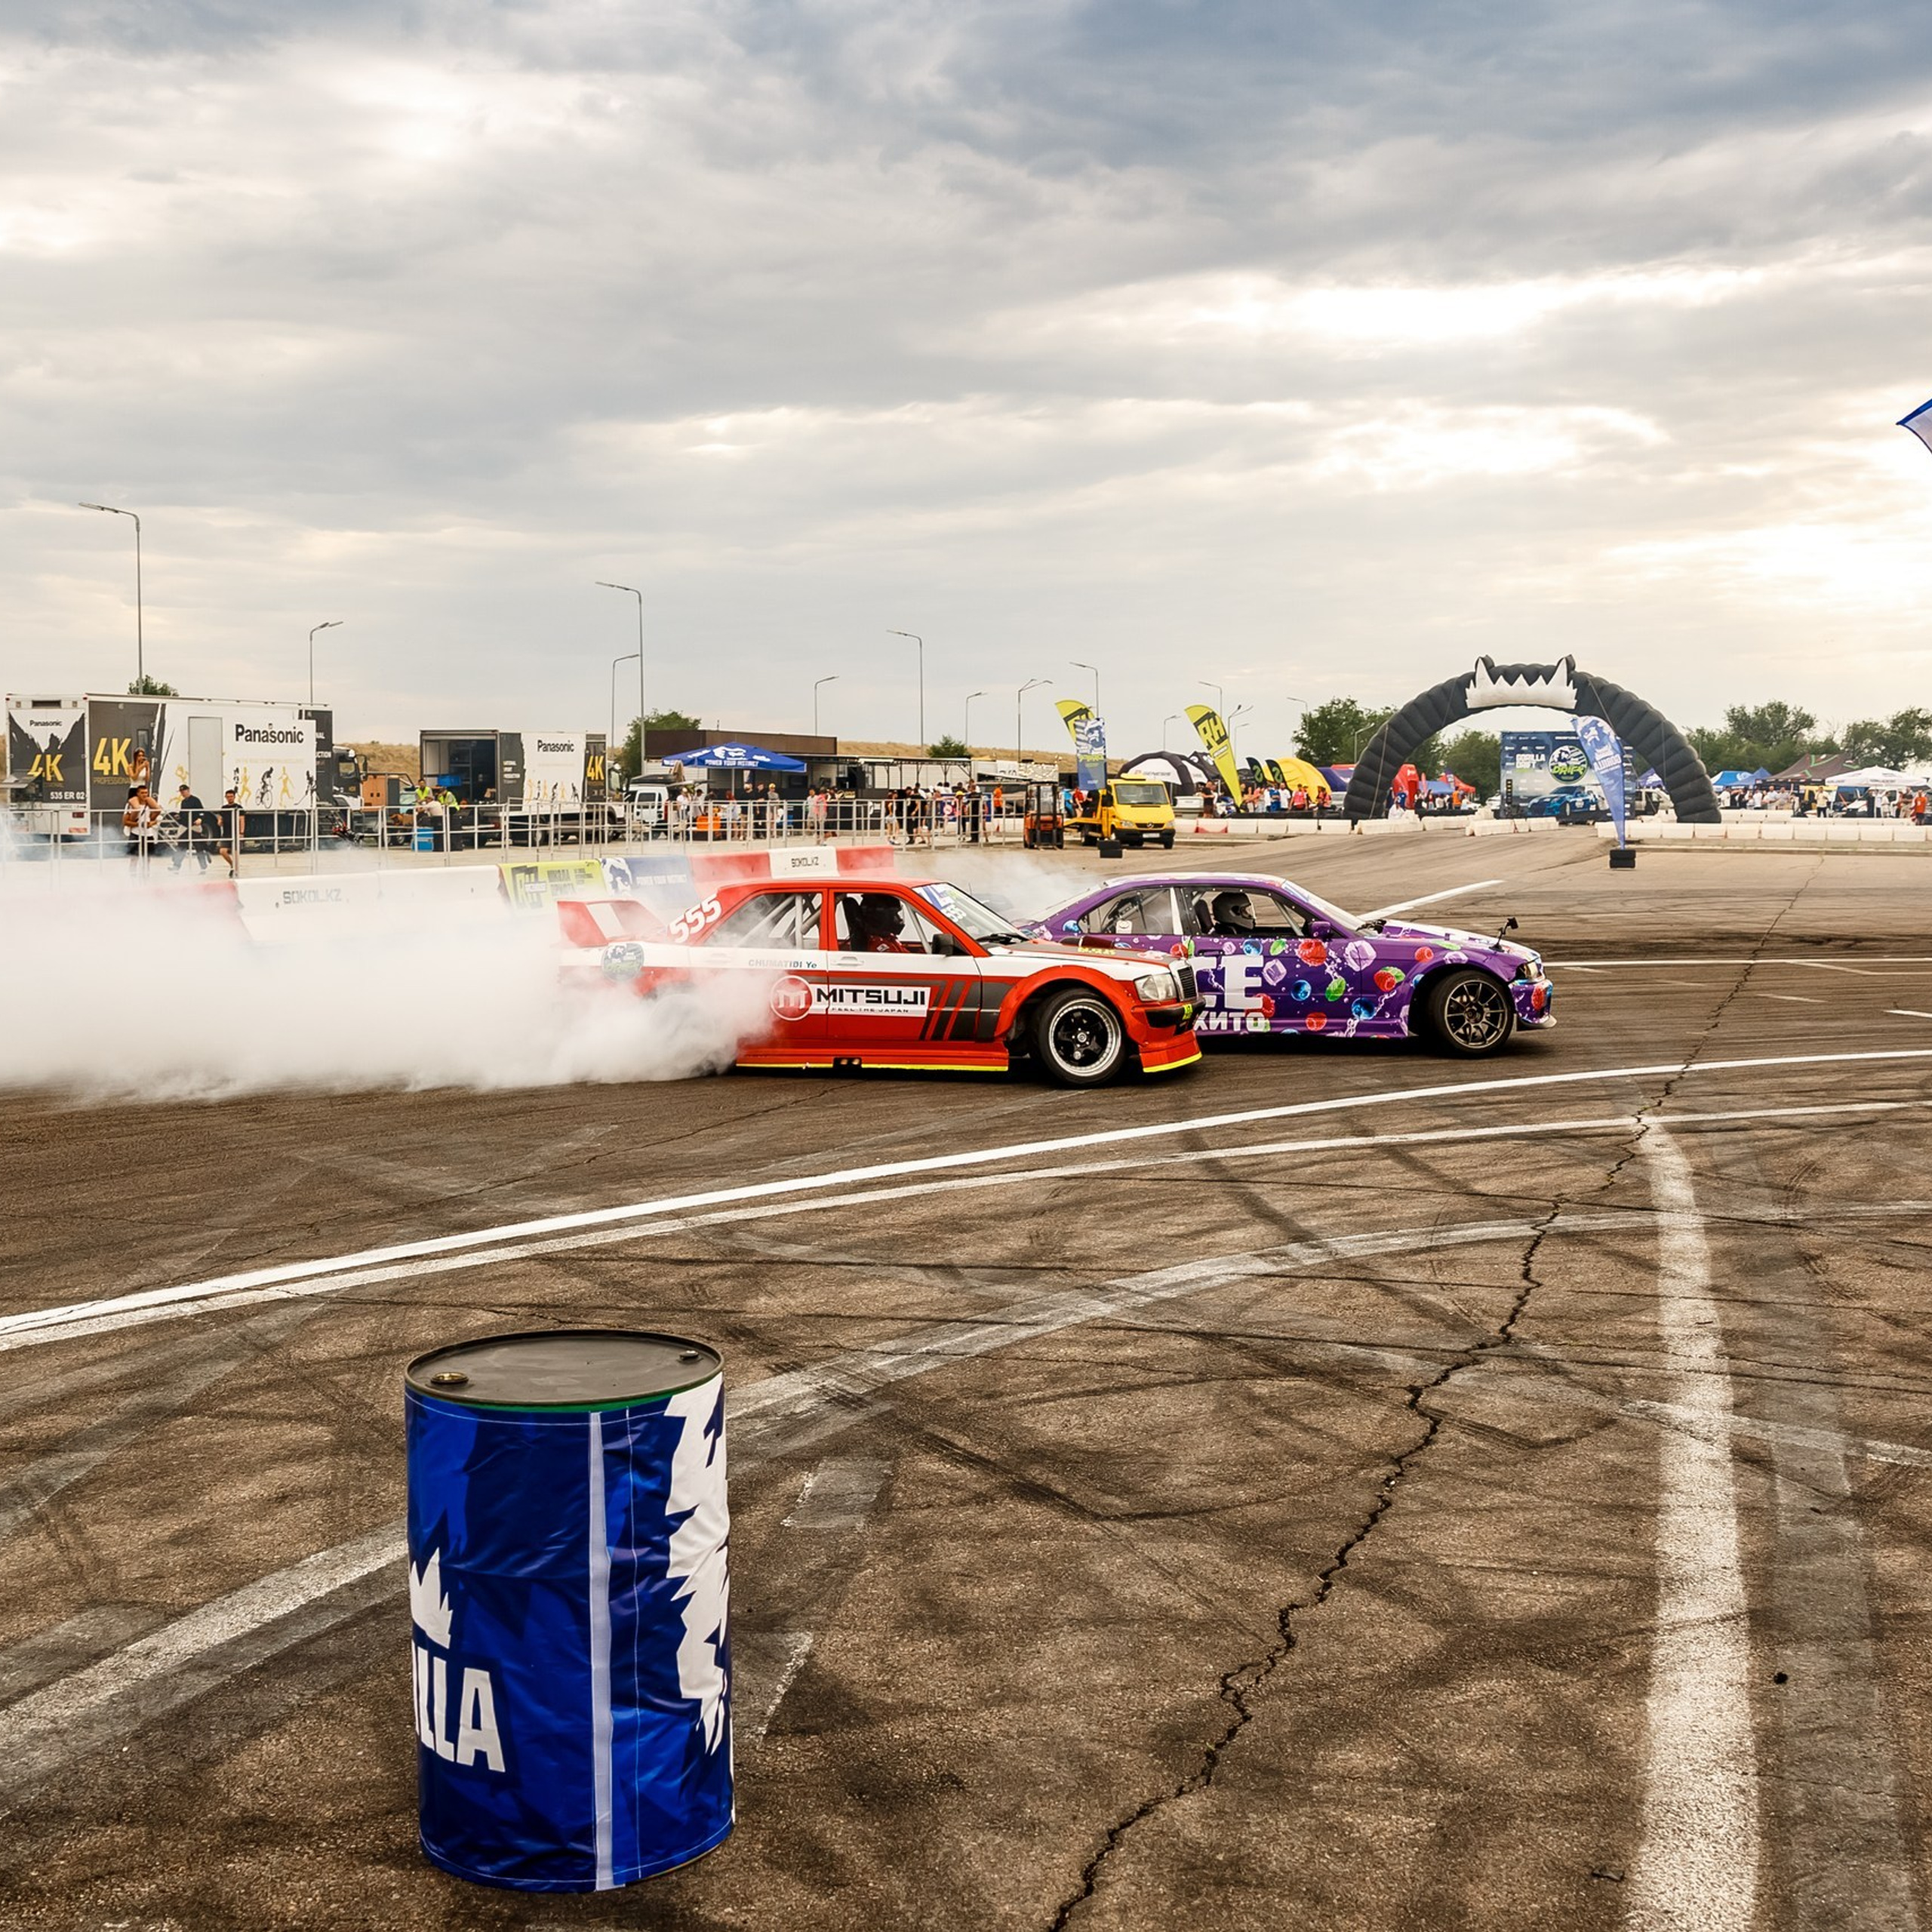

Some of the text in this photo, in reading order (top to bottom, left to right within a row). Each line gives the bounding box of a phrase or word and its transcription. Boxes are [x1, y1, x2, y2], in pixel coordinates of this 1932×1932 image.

[235, 723, 304, 744] Panasonic
[94, 737, 132, 776] 4K
[537, 740, 574, 752] Panasonic
[27, 754, 64, 782] 4K
[586, 755, 605, 780] 4K
[63, 792, 75, 800] ER
[669, 894, 722, 943] 555
[817, 987, 925, 1005] MITSUJI
